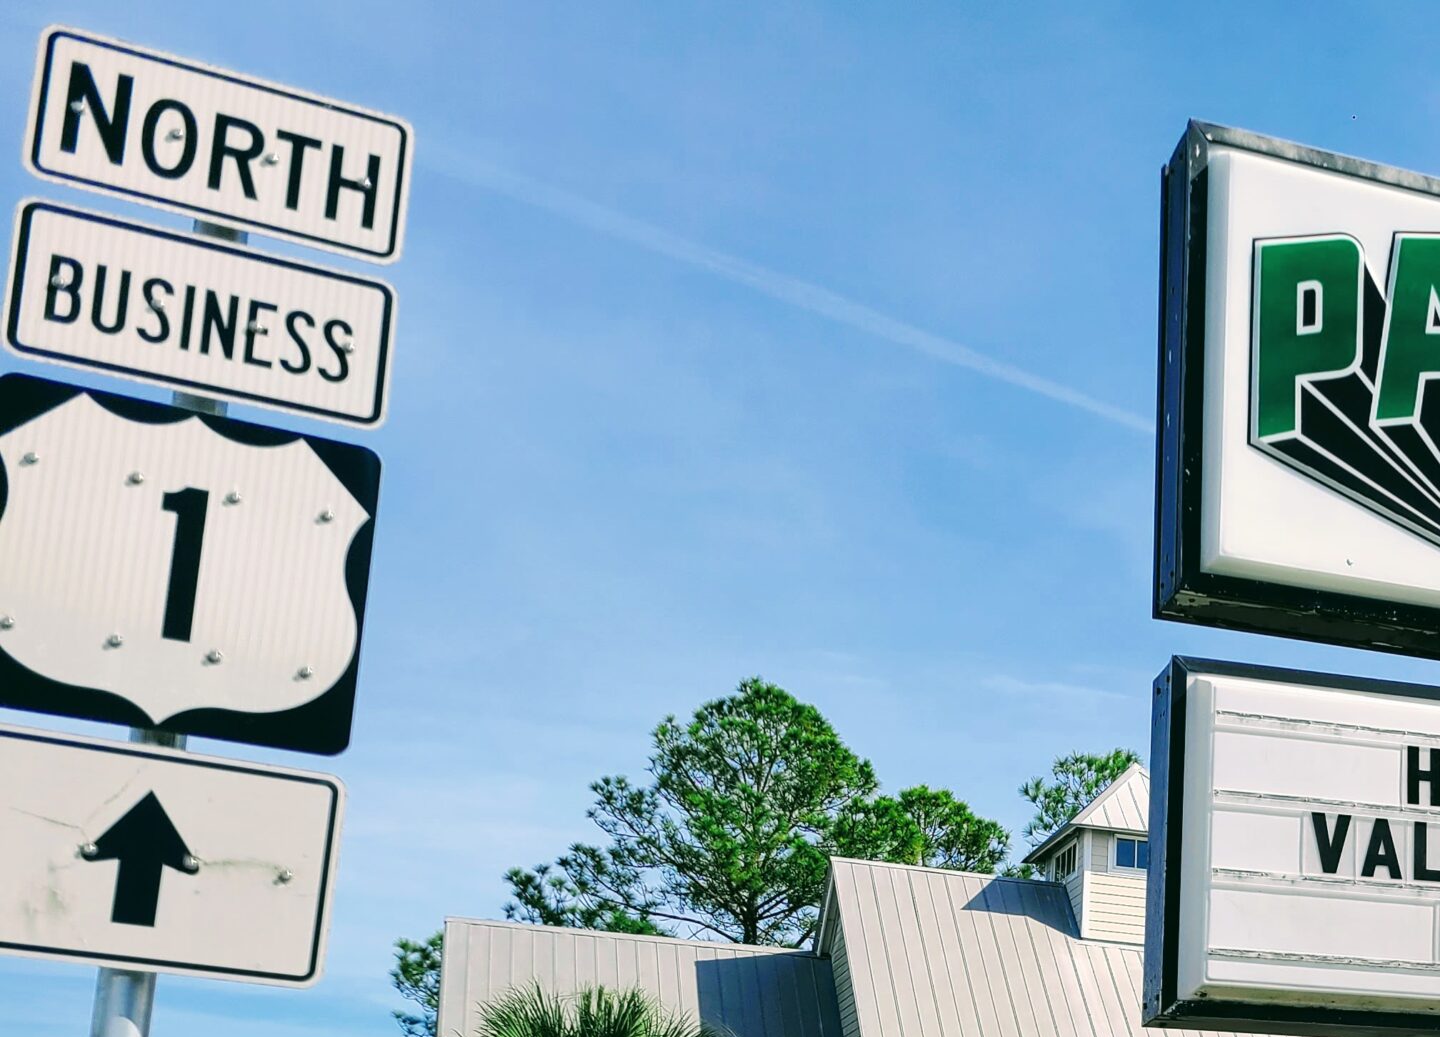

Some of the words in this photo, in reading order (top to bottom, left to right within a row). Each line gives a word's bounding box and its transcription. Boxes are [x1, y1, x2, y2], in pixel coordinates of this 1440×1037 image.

[60, 60, 381, 231] NORTH
[43, 253, 354, 383] BUSINESS
[161, 486, 210, 643] 1
